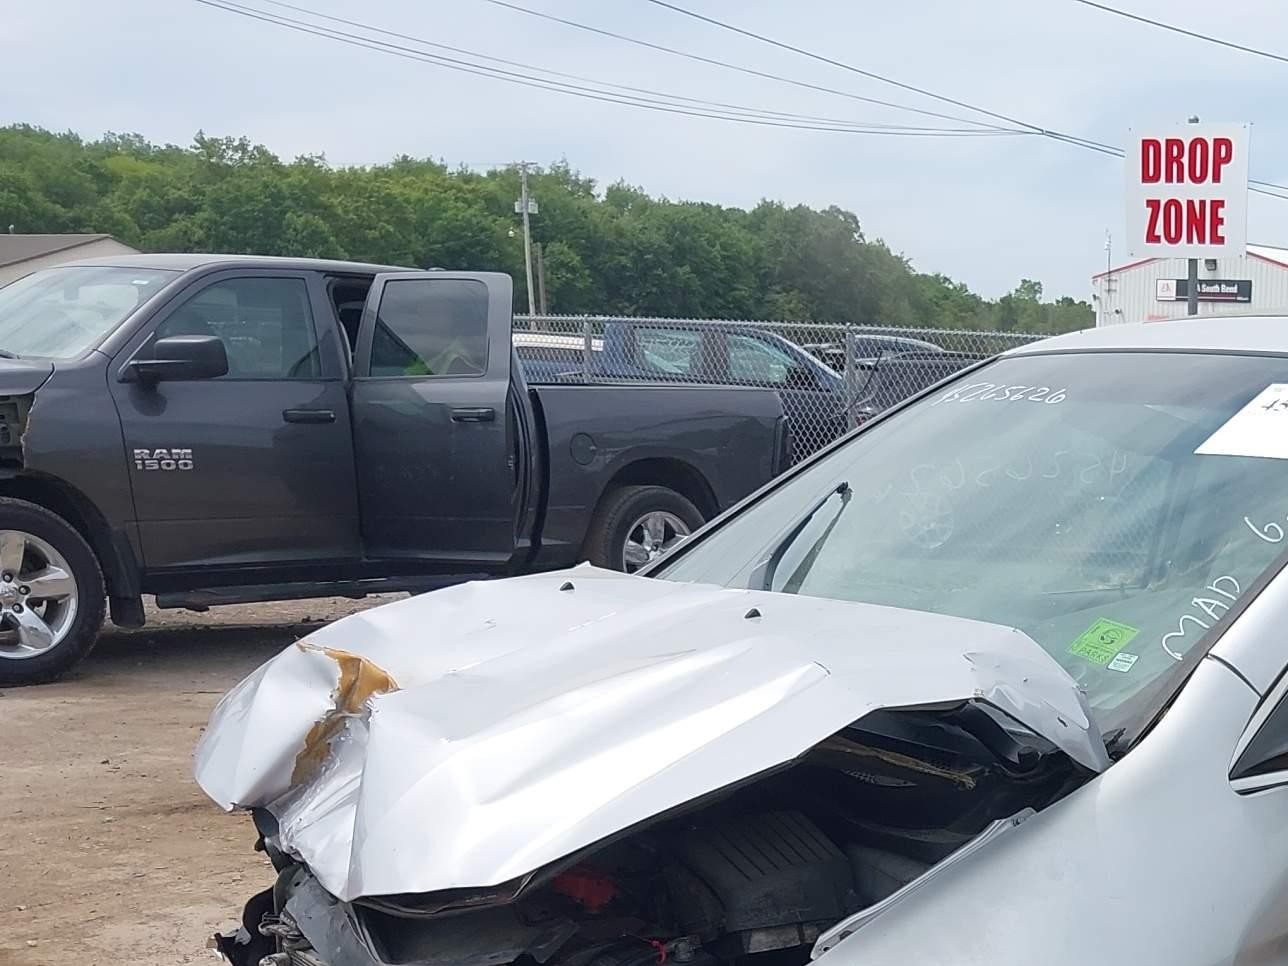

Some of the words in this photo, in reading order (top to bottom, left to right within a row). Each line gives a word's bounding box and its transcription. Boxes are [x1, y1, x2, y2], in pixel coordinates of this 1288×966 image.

[1141, 137, 1233, 184] DROP
[1145, 198, 1226, 245] ZONE
[133, 448, 193, 459] RAM
[134, 459, 194, 470] 1500
[1162, 575, 1241, 661] MAD
